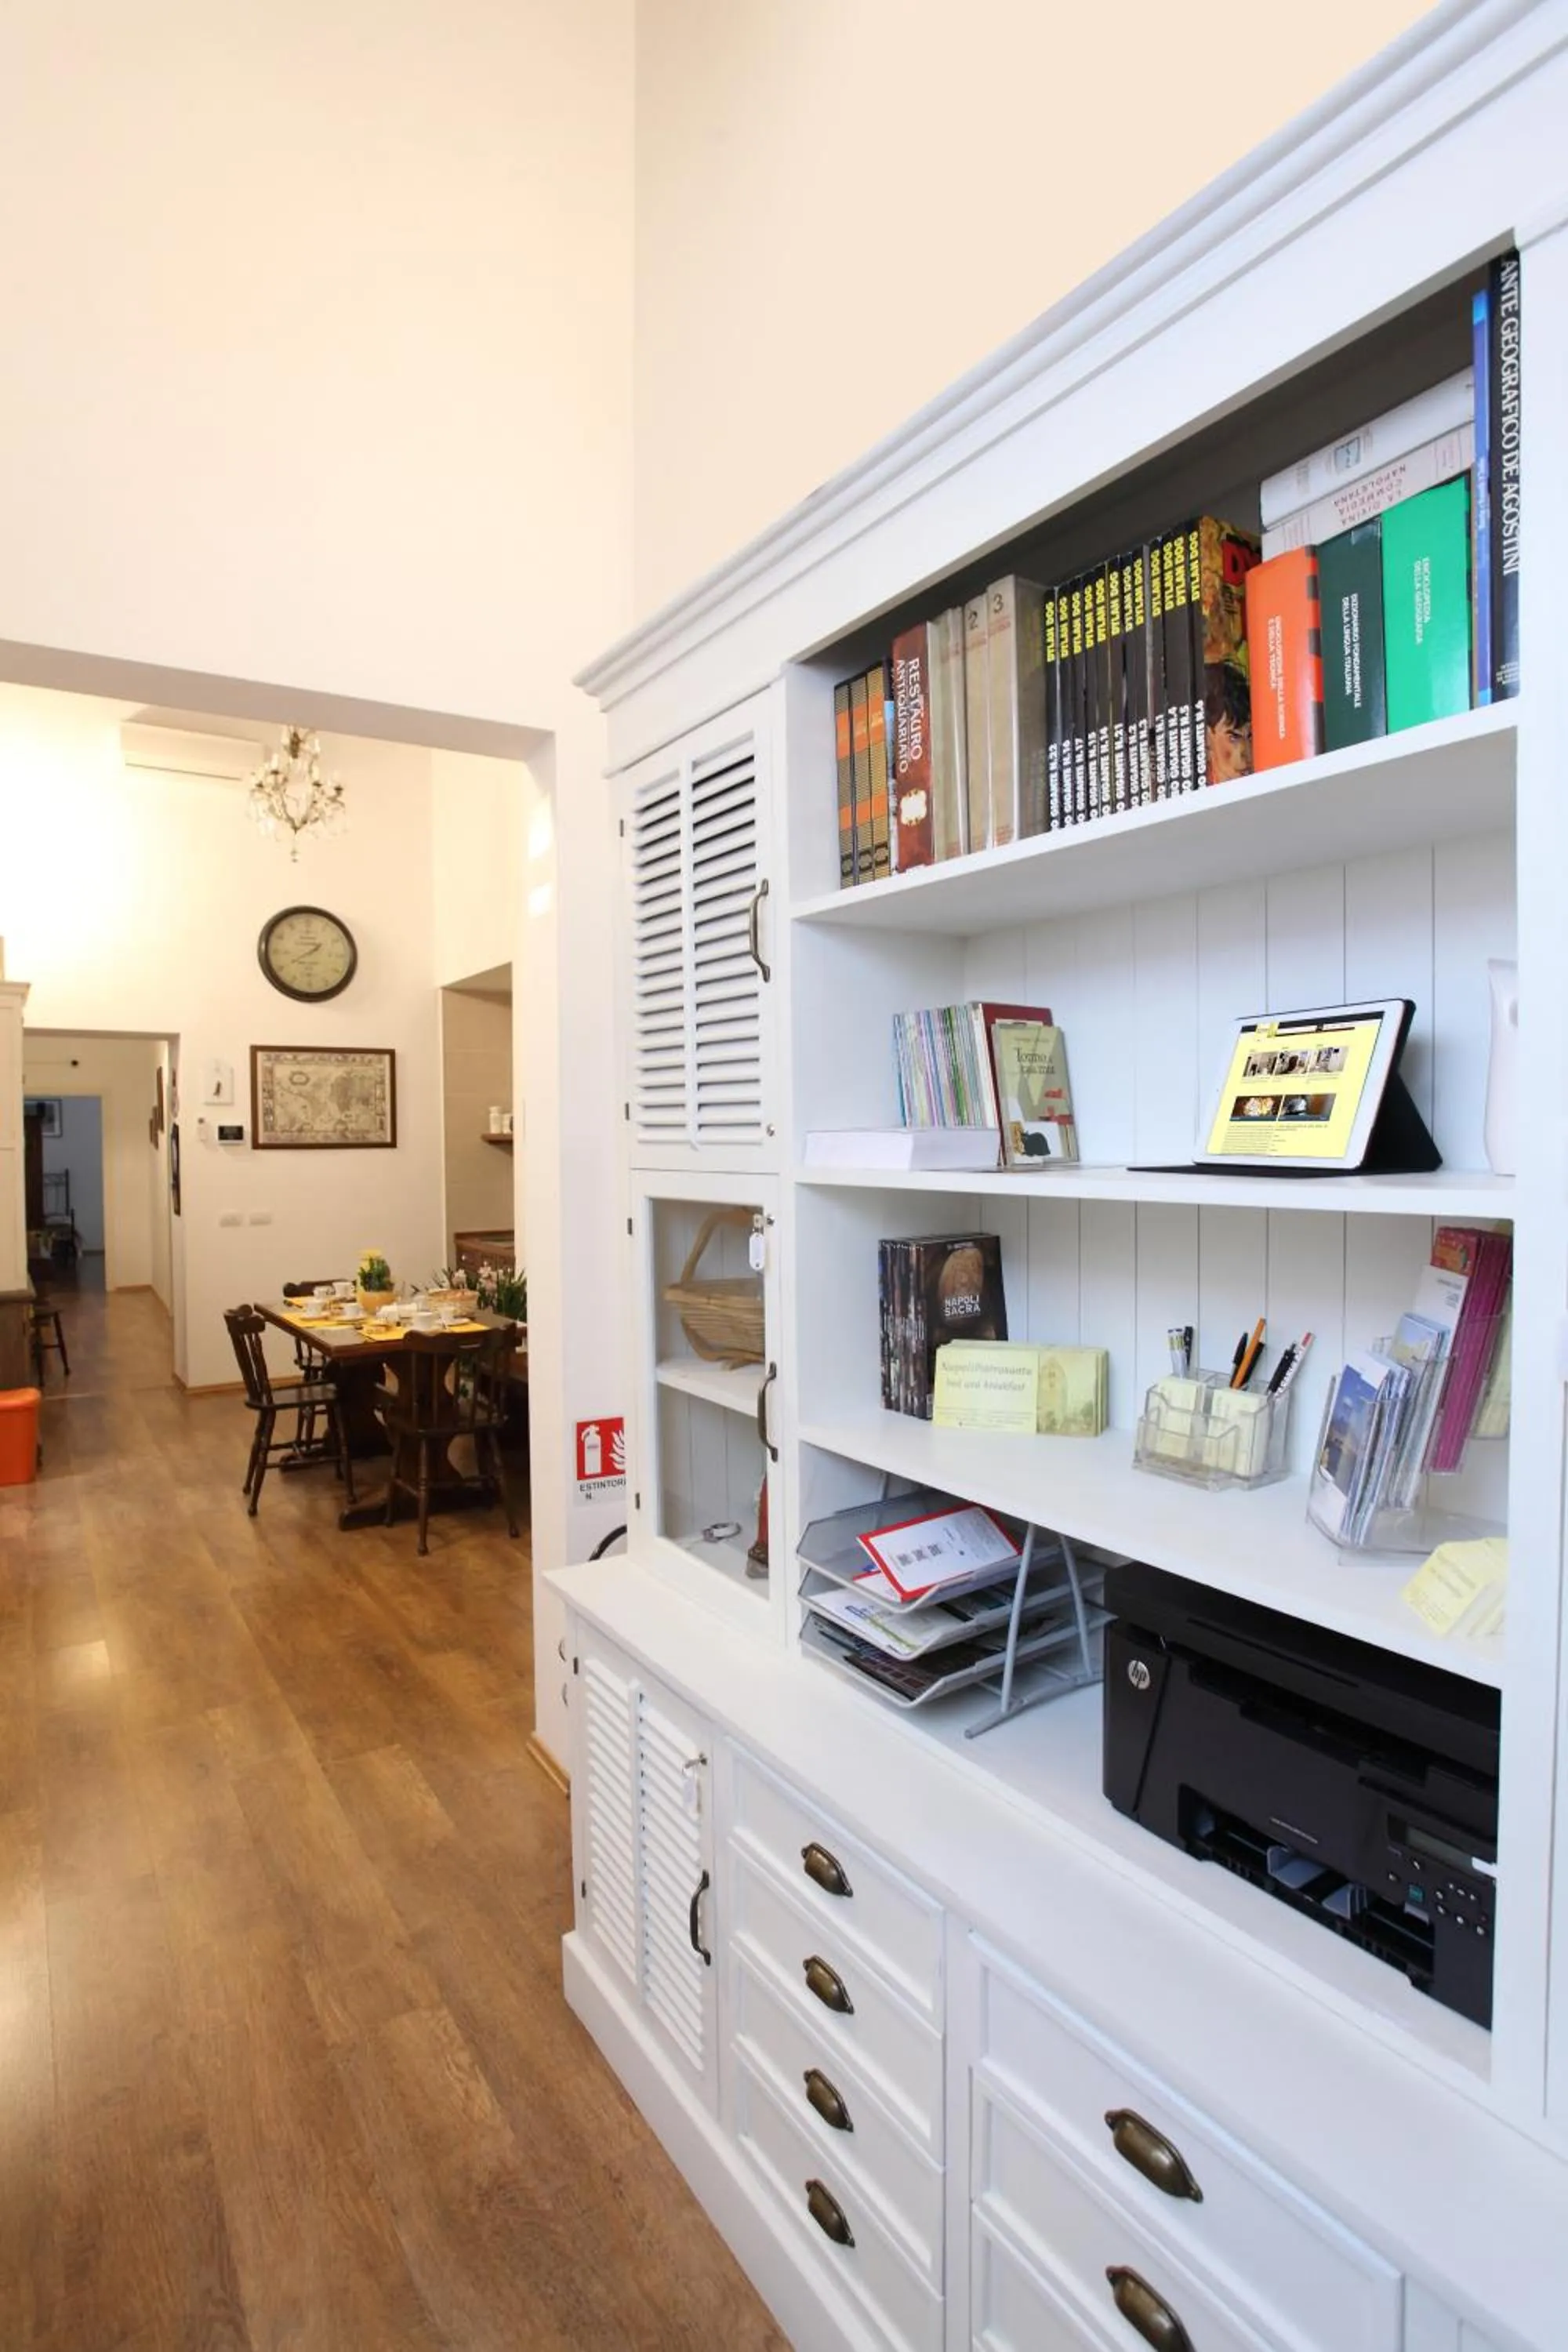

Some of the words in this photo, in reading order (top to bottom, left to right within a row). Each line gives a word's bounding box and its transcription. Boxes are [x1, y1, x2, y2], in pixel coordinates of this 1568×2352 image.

[1501, 260, 1519, 318] ANTE
[1501, 317, 1519, 449] GEOGRAFICO
[1501, 451, 1519, 481] DE
[1189, 530, 1199, 561] DOG
[1501, 483, 1519, 576] AGOSTINI
[1151, 549, 1160, 577] DOG
[1163, 541, 1173, 570] DOG
[1174, 535, 1185, 566] DOG
[1109, 571, 1120, 598] DOG
[1123, 565, 1131, 593] DOG
[1134, 557, 1142, 586] DOG
[1175, 564, 1186, 606] DYLAN
[1190, 559, 1200, 602] DYLAN
[993, 593, 1004, 615] 3
[1072, 591, 1081, 617] DOG
[1084, 584, 1093, 611] DOG
[1095, 578, 1105, 604] DOG
[1134, 586, 1144, 626] DYLAN
[1152, 577, 1161, 617] DYLAN
[1164, 570, 1174, 612] DYLAN
[968, 610, 978, 631] 2
[1046, 601, 1054, 626] DOG
[1059, 597, 1068, 622] DOG
[1096, 604, 1106, 642] DYLAN
[1110, 598, 1120, 636] DYLAN
[1123, 593, 1133, 632] DYLAN
[1046, 626, 1055, 662] DYLAN
[1060, 622, 1069, 659] DYLAN
[1073, 618, 1082, 654] DYLAN
[1085, 612, 1094, 649] DYLAN
[1352, 643, 1362, 709] FONDAMENTALE
[895, 659, 909, 775] ANTIQUARIATO
[908, 657, 924, 760] RESTAURO
[1155, 713, 1164, 734] N.1
[1179, 704, 1190, 727] N.5
[1195, 699, 1205, 722] N.6
[1099, 725, 1109, 754] N.14
[1113, 722, 1123, 751] N.21
[1128, 723, 1138, 746] N.2
[1138, 717, 1149, 742] N.3
[1196, 721, 1207, 774] GIGANTE
[1048, 742, 1058, 771] N.22
[1062, 739, 1071, 766] N.16
[1074, 737, 1083, 764] N.17
[1139, 740, 1149, 789] GIGANTE
[1156, 733, 1166, 782] GIGANTE
[1169, 728, 1179, 779] GIGANTE
[1180, 727, 1191, 778] GIGANTE
[1075, 764, 1085, 811] GIGANTE
[1088, 759, 1098, 807] GIGANTE
[1100, 753, 1110, 802] GIGANTE
[1114, 750, 1125, 799] GIGANTE
[1129, 745, 1139, 794] GIGANTE
[1049, 770, 1059, 817] GIGANTE
[1062, 766, 1073, 813] GIGANTE
[944, 1294, 980, 1307] NAPOLI
[944, 1304, 982, 1317] SACRA
[1131, 1660, 1148, 1688] hp
